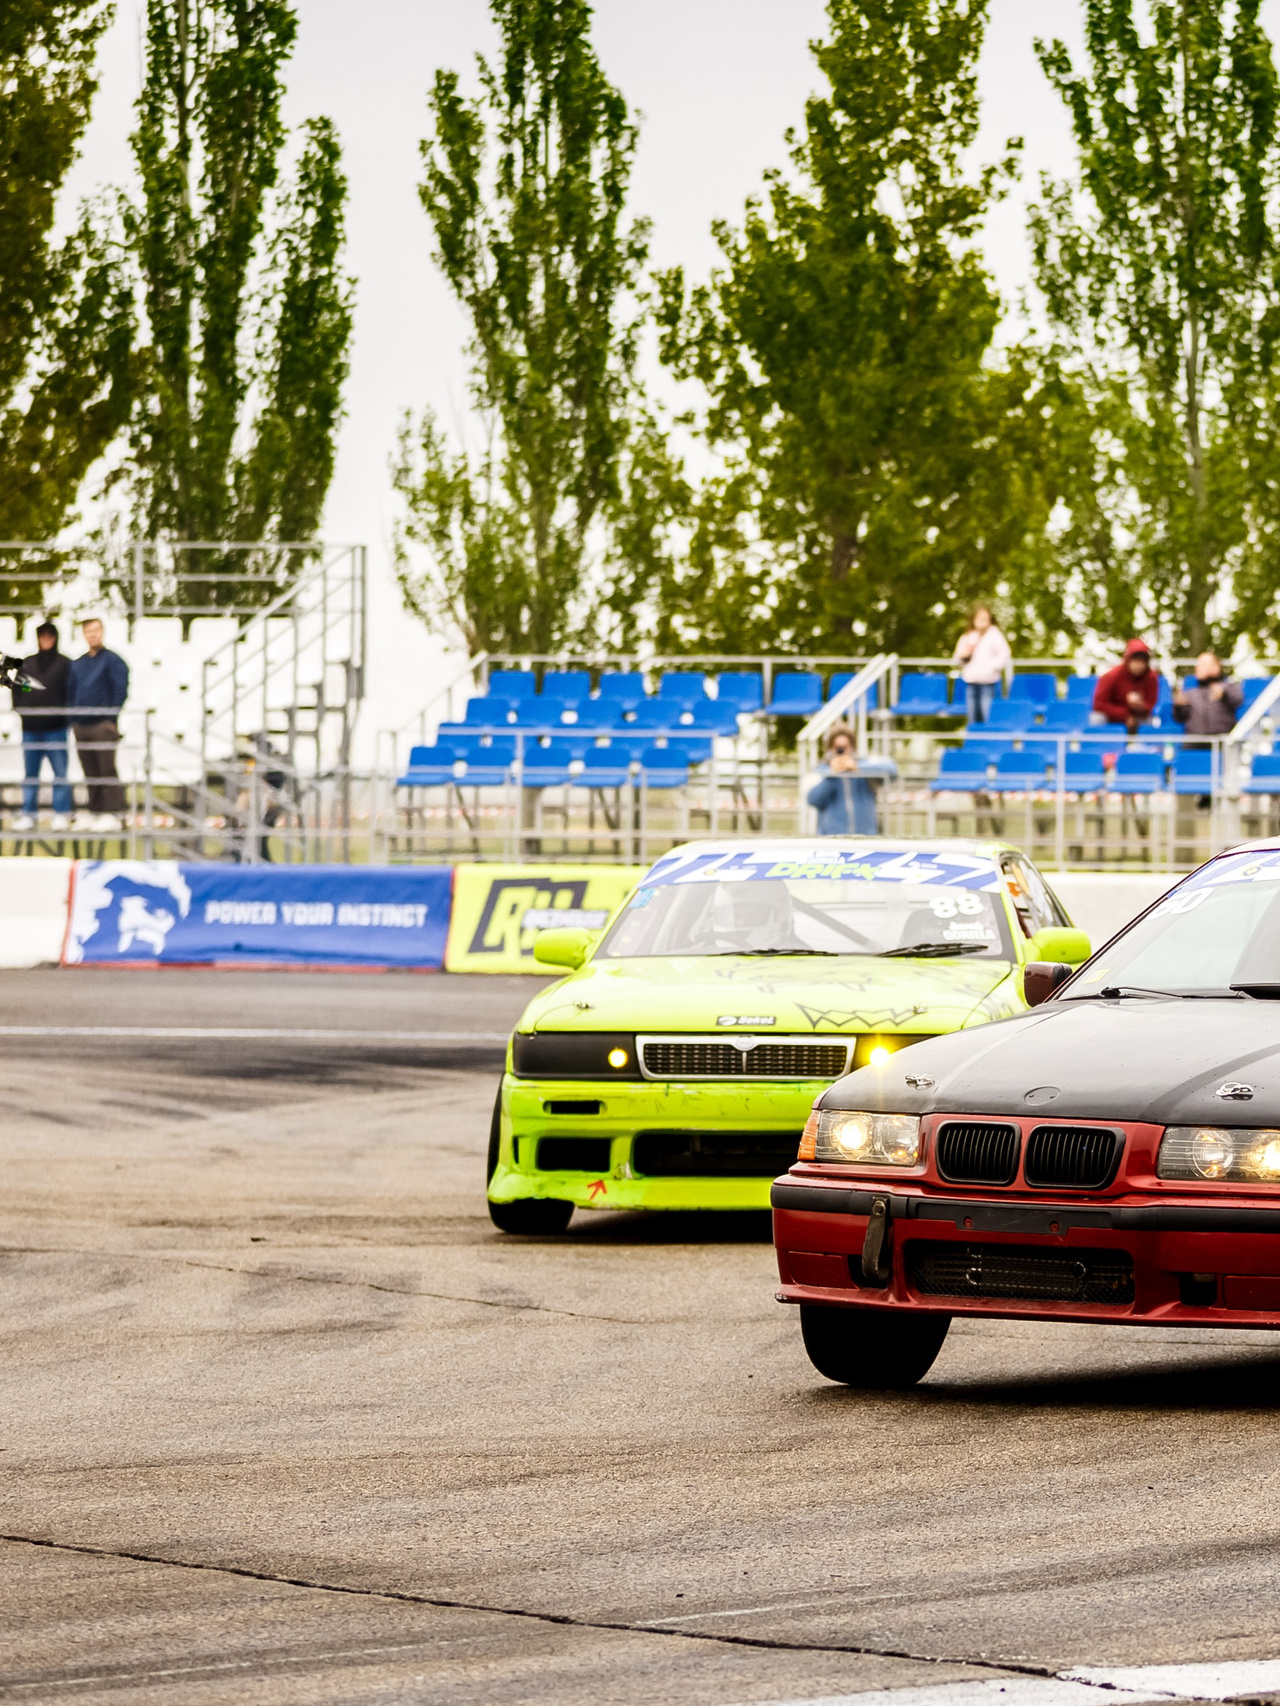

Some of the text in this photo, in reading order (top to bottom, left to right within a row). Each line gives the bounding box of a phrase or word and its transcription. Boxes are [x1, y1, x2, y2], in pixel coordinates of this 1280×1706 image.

[205, 900, 428, 928] POWER YOUR INSTINCT
[929, 893, 984, 919] 88
[943, 928, 996, 940] GORILLA
